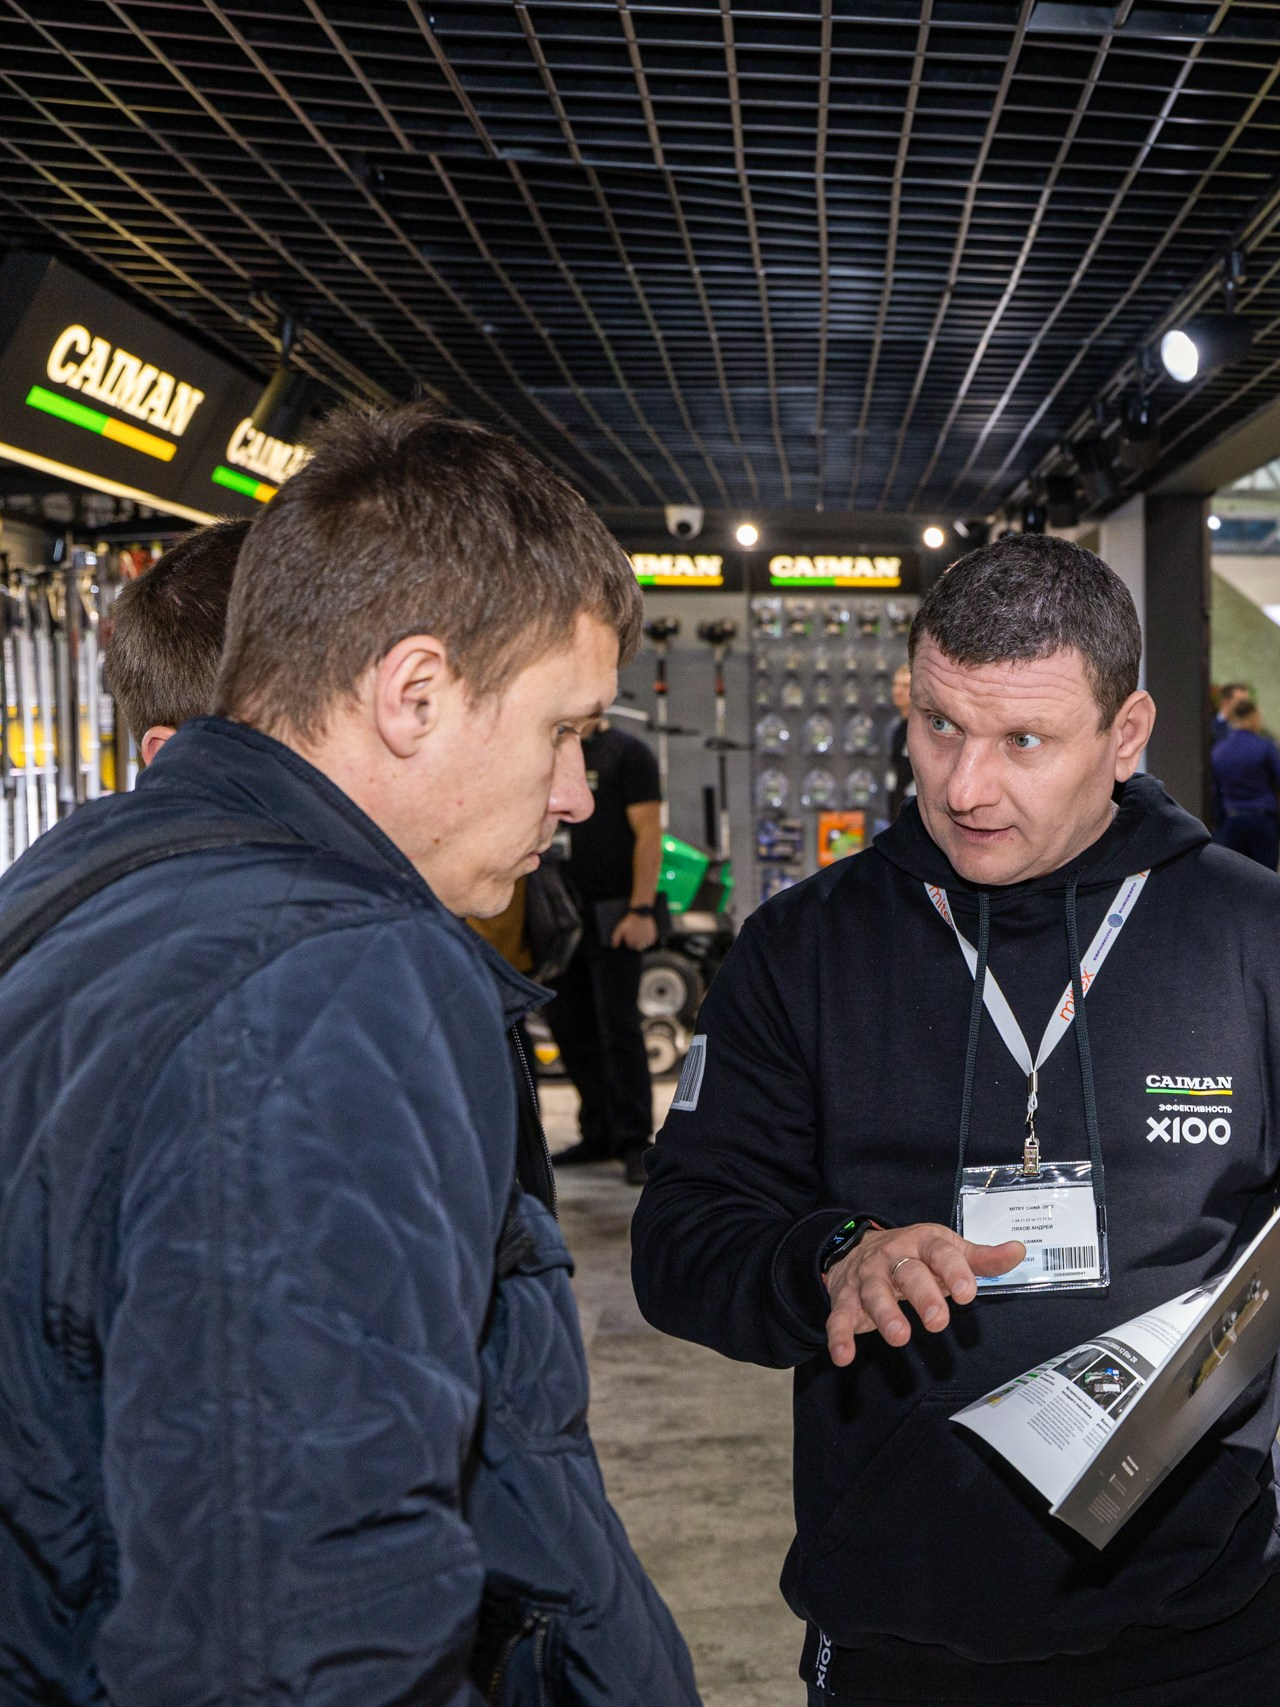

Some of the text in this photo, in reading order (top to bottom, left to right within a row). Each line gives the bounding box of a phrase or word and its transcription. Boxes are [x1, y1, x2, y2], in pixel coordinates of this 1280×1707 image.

[46, 323, 206, 437] CAIMAN
[226, 417, 314, 485] CAIMA
[631, 553, 724, 577] IMAN
[769, 554, 902, 579] CAIMAN
[1118, 882, 1137, 914] EUROEXPO
[1145, 1074, 1233, 1090] CAIMAN
[1158, 1103, 1233, 1114] ЭФФЕКТИВНОСТЬ
